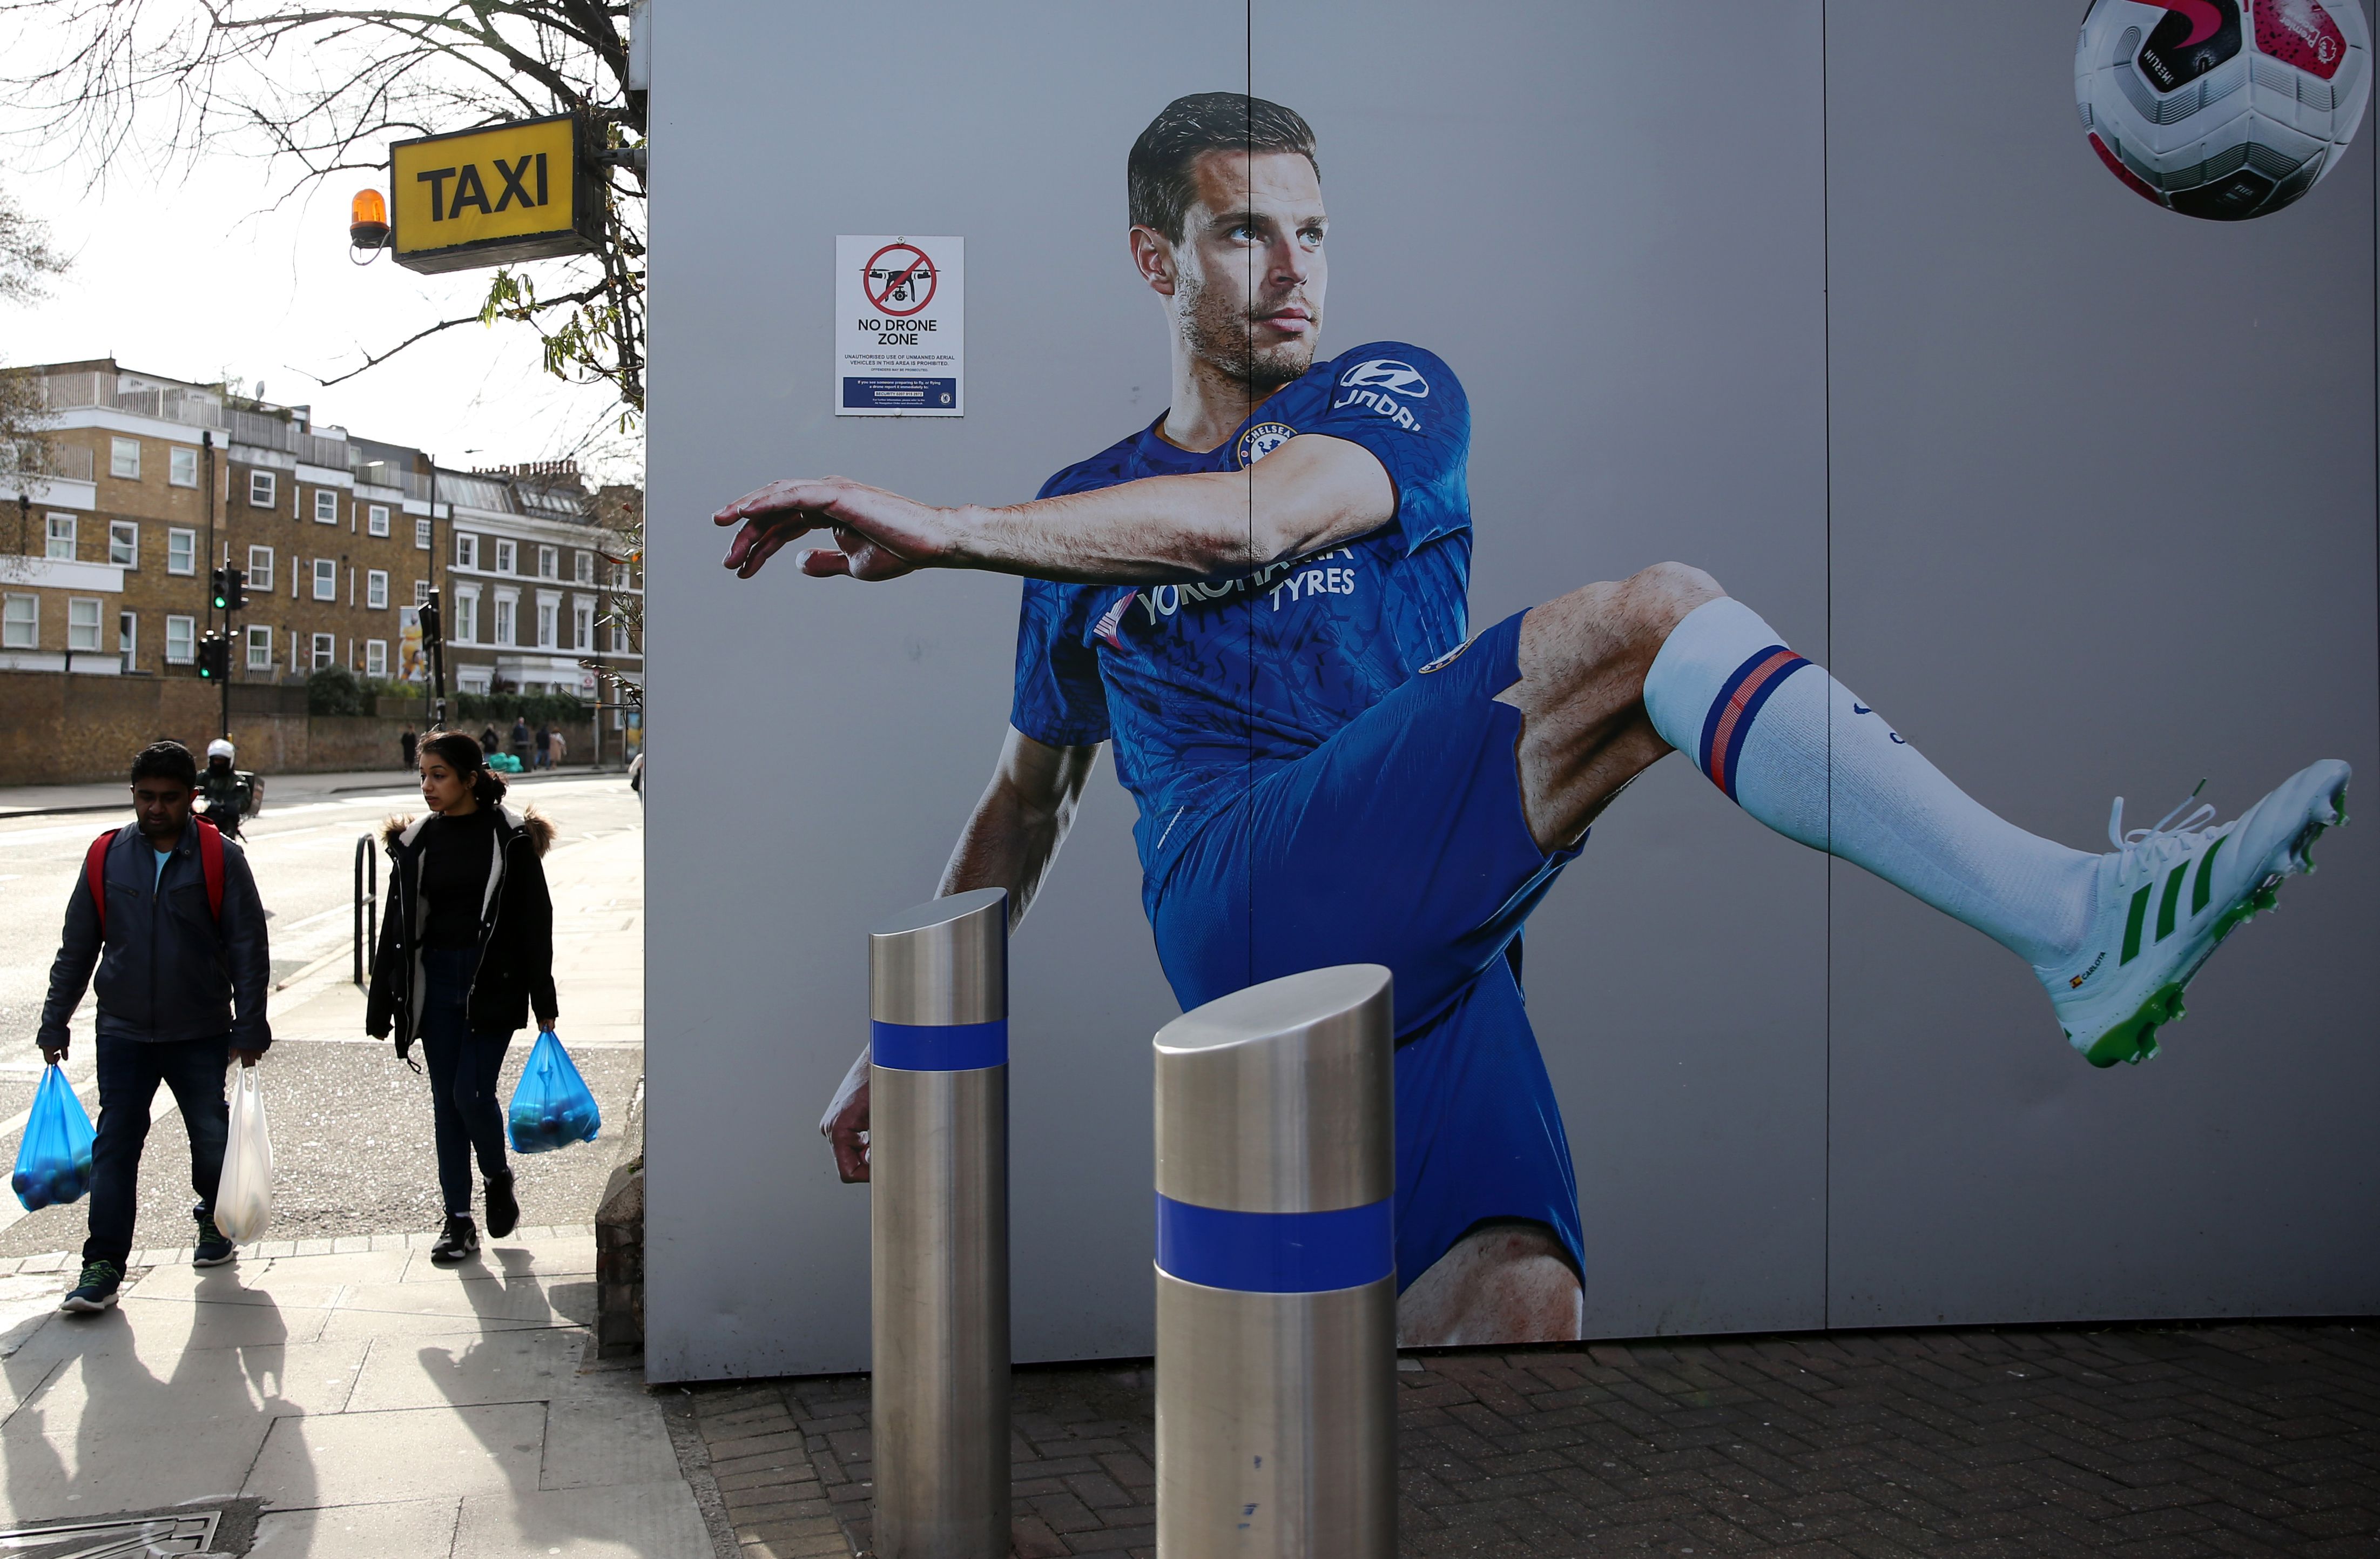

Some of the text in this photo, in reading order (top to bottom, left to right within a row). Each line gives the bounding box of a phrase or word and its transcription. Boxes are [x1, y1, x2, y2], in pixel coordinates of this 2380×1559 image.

[417, 152, 549, 222] TAXI
[2234, 185, 2254, 196] FIFA
[858, 319, 937, 332] NO DRONE
[878, 333, 918, 345] ZONE
[1245, 425, 1290, 443] CHELSEA
[1269, 568, 1355, 612] TYRES
[2081, 952, 2106, 980] CARLOTA
